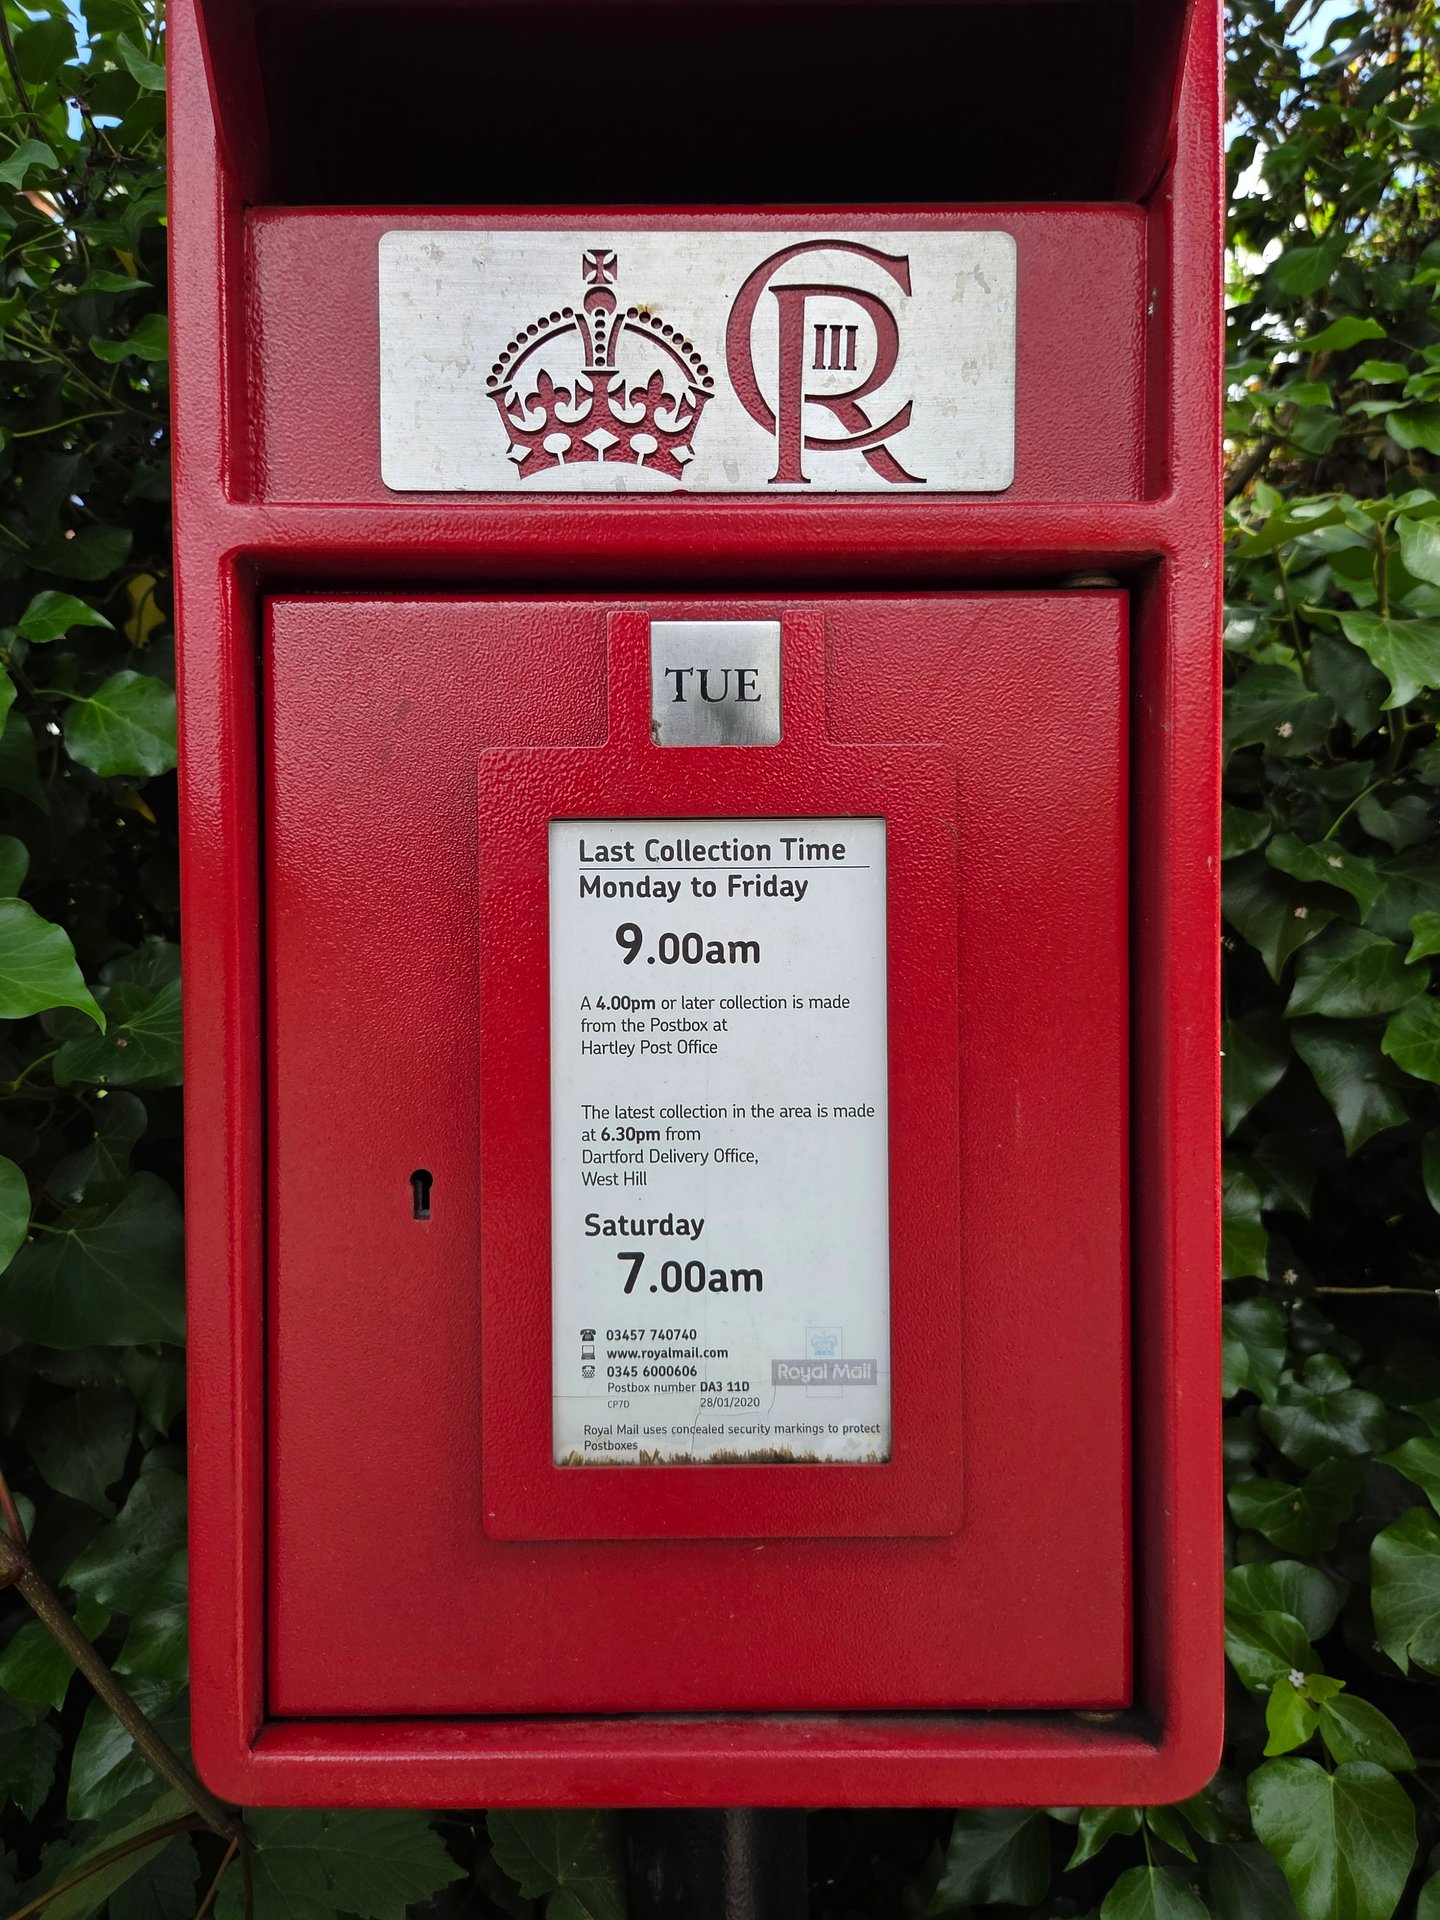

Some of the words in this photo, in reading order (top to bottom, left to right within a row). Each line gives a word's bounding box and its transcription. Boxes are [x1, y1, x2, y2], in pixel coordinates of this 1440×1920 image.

[665, 667, 762, 702] TUE
[580, 839, 635, 862] Last
[645, 838, 770, 862] Collection
[780, 837, 845, 861] Time
[580, 875, 681, 903] Monday
[691, 877, 716, 897] to
[728, 874, 808, 902] Friday
[616, 923, 760, 965] 9.00am
[581, 996, 591, 1010] A
[596, 996, 655, 1013] 4.00pm
[662, 1000, 677, 1009] or
[682, 995, 715, 1009] later
[720, 995, 786, 1009] collection
[793, 995, 803, 1008] is
[809, 994, 850, 1008] made
[581, 1018, 615, 1032] from
[621, 1018, 645, 1032] the
[651, 1018, 708, 1032] Postbox
[713, 1019, 727, 1031] at
[582, 1040, 635, 1057] Hartley
[641, 1040, 672, 1054] Post
[678, 1040, 717, 1054] Office
[581, 1105, 609, 1119] The
[615, 1105, 655, 1119] latest
[660, 1104, 727, 1118] collection
[733, 1104, 745, 1118] in
[751, 1104, 774, 1118] the
[780, 1108, 811, 1118] area
[818, 1104, 828, 1117] is
[833, 1103, 874, 1117] made
[582, 1129, 596, 1141] at
[601, 1127, 660, 1144] 6.30pm
[666, 1127, 700, 1140] from
[583, 1149, 644, 1163] Dartford
[650, 1149, 709, 1166] Delivery
[714, 1148, 758, 1164] Office,
[582, 1172, 619, 1186] West
[624, 1171, 647, 1186] Hill
[585, 1213, 704, 1241] Saturday
[617, 1252, 762, 1294] 7.00am
[607, 1330, 645, 1341] 03457
[650, 1329, 696, 1340] 740740
[607, 1347, 728, 1361] www.royalmail.com
[607, 1366, 637, 1377] 0345
[643, 1366, 697, 1377] 6000606
[777, 1362, 828, 1381] Royal
[832, 1361, 871, 1379] Mail
[608, 1382, 649, 1392] Postbox
[654, 1382, 696, 1392] number
[701, 1381, 722, 1392] DA3
[700, 1397, 760, 1408] 28/01/2020
[584, 1425, 612, 1437] Royal
[617, 1424, 639, 1434] Mail
[672, 1424, 724, 1434] concealed
[728, 1424, 770, 1435] security
[775, 1423, 824, 1435] markings
[828, 1424, 838, 1433] to
[843, 1424, 880, 1435] protect
[585, 1440, 638, 1451] Postboxes
